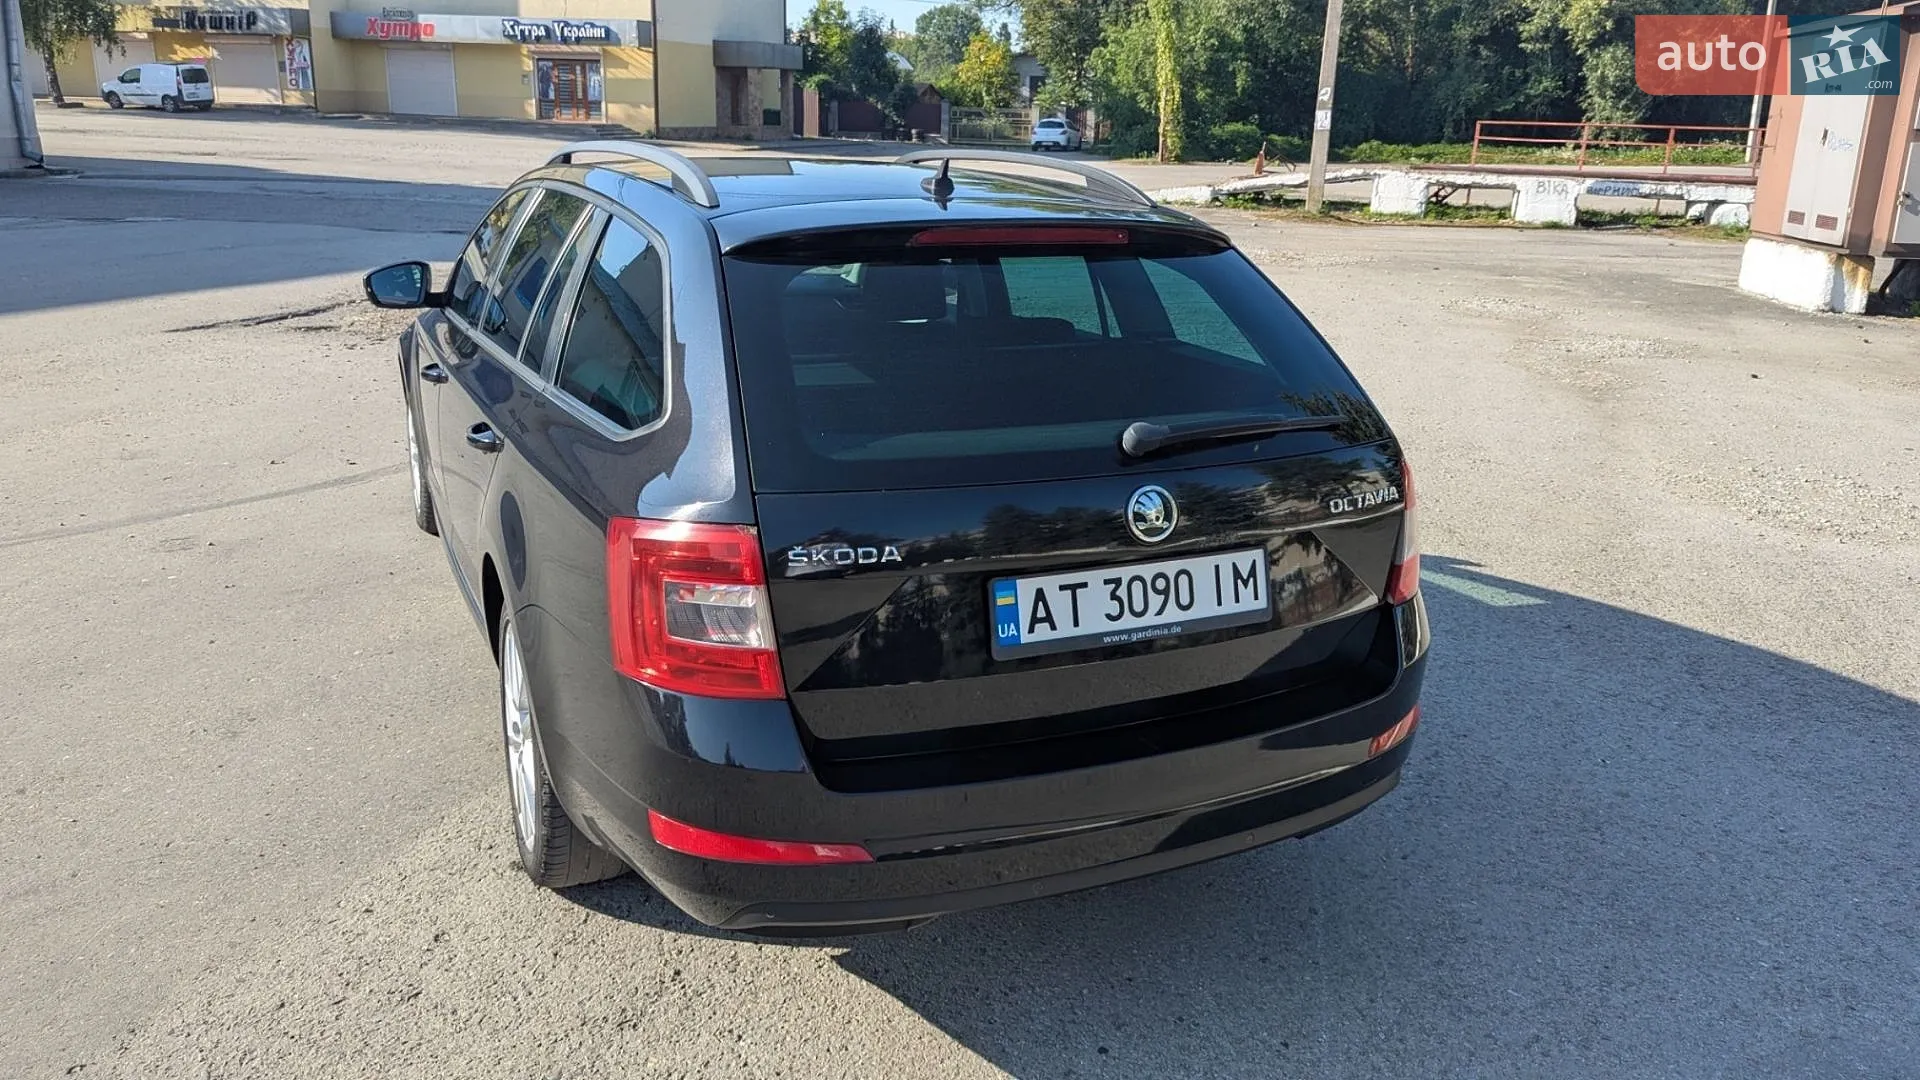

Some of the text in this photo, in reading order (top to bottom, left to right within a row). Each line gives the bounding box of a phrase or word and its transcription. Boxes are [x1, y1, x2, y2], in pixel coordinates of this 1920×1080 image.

[502, 19, 606, 41] Хутра України
[1329, 486, 1399, 513] OCTAVIA
[788, 546, 902, 567] ŠKODA
[1027, 558, 1259, 634] AT 3090 IM
[998, 623, 1018, 638] UA
[1103, 625, 1182, 643] www.gardinia.de
